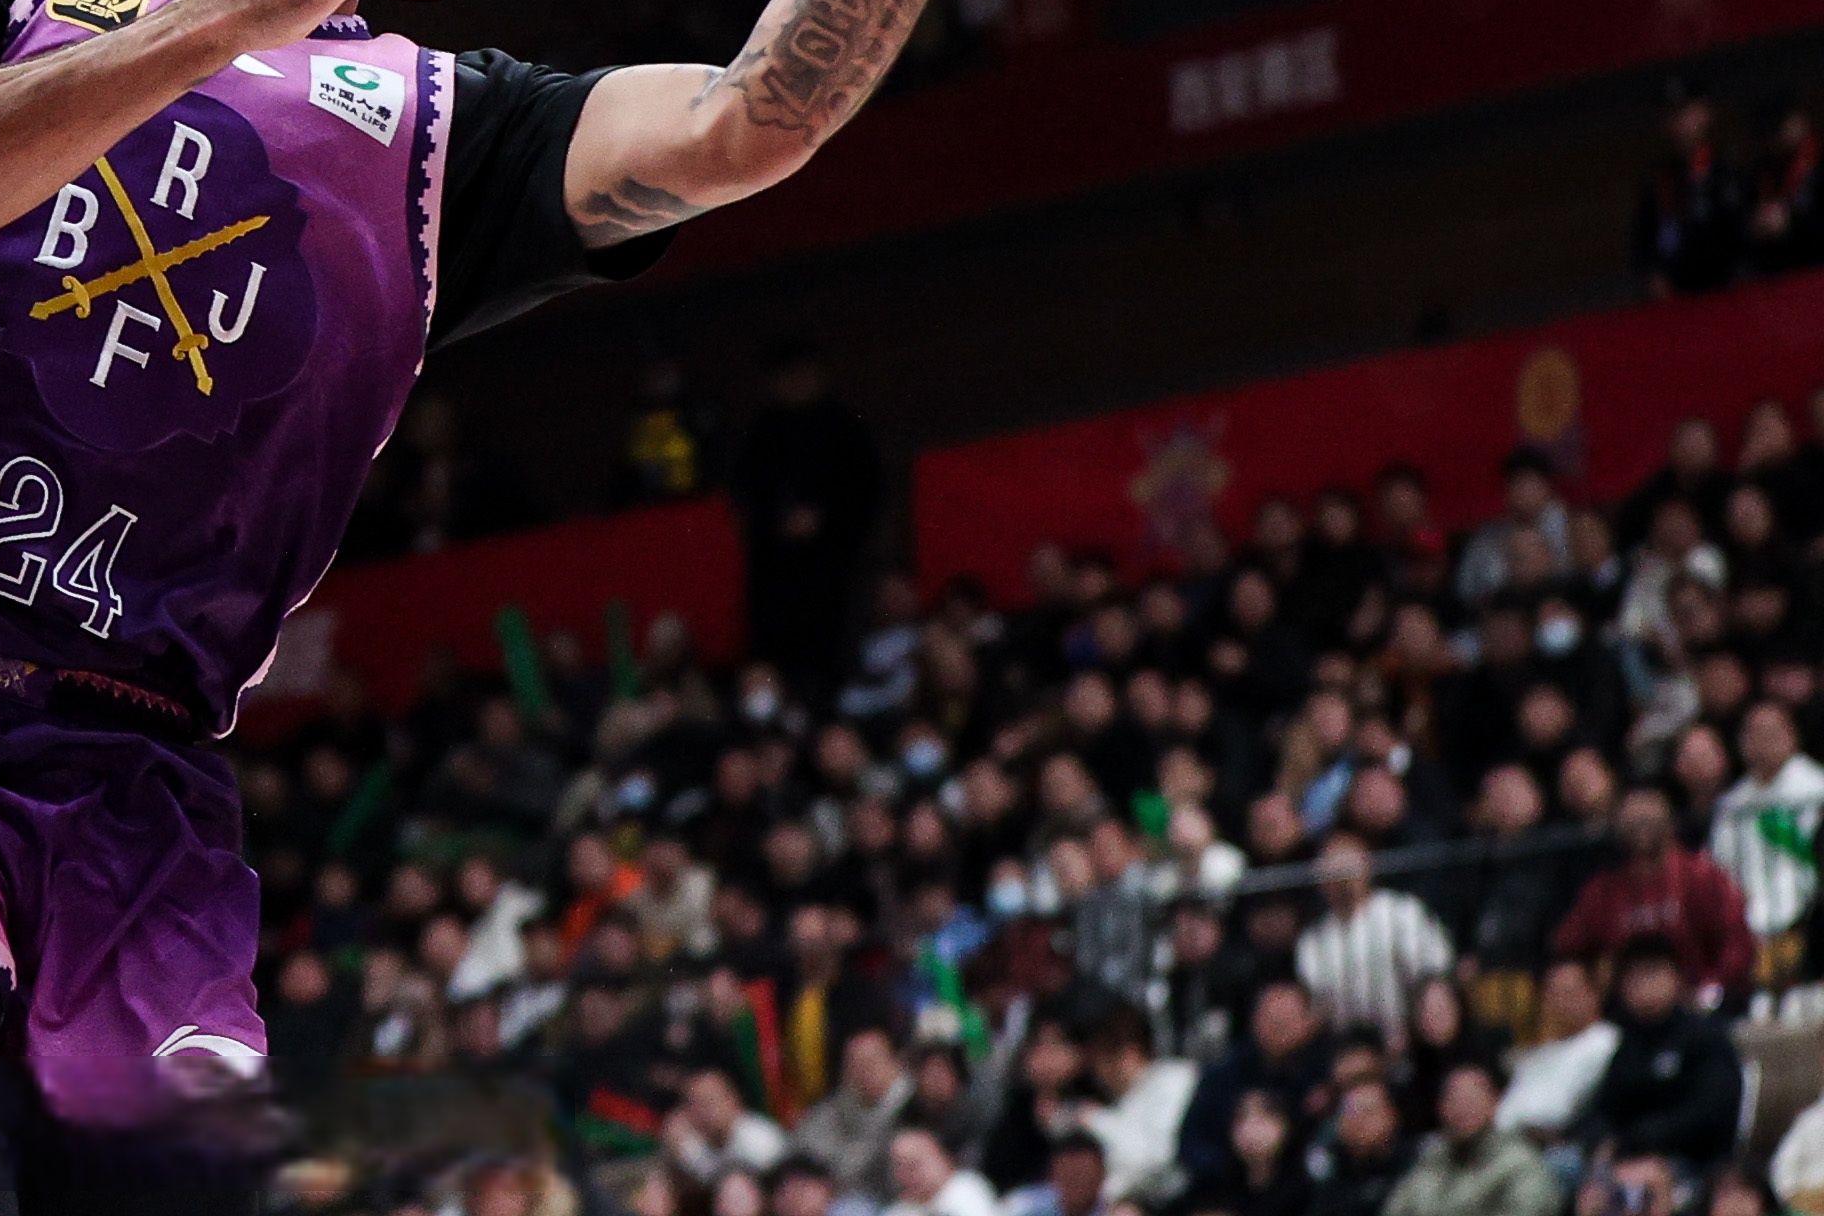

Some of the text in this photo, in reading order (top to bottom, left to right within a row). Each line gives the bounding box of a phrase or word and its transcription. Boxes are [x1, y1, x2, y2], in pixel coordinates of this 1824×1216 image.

[75, 0, 121, 24] CBA
[319, 93, 387, 132] CHINA LIFE
[320, 82, 391, 120] 中国人寿
[150, 120, 214, 220] R
[88, 261, 267, 388] F J
